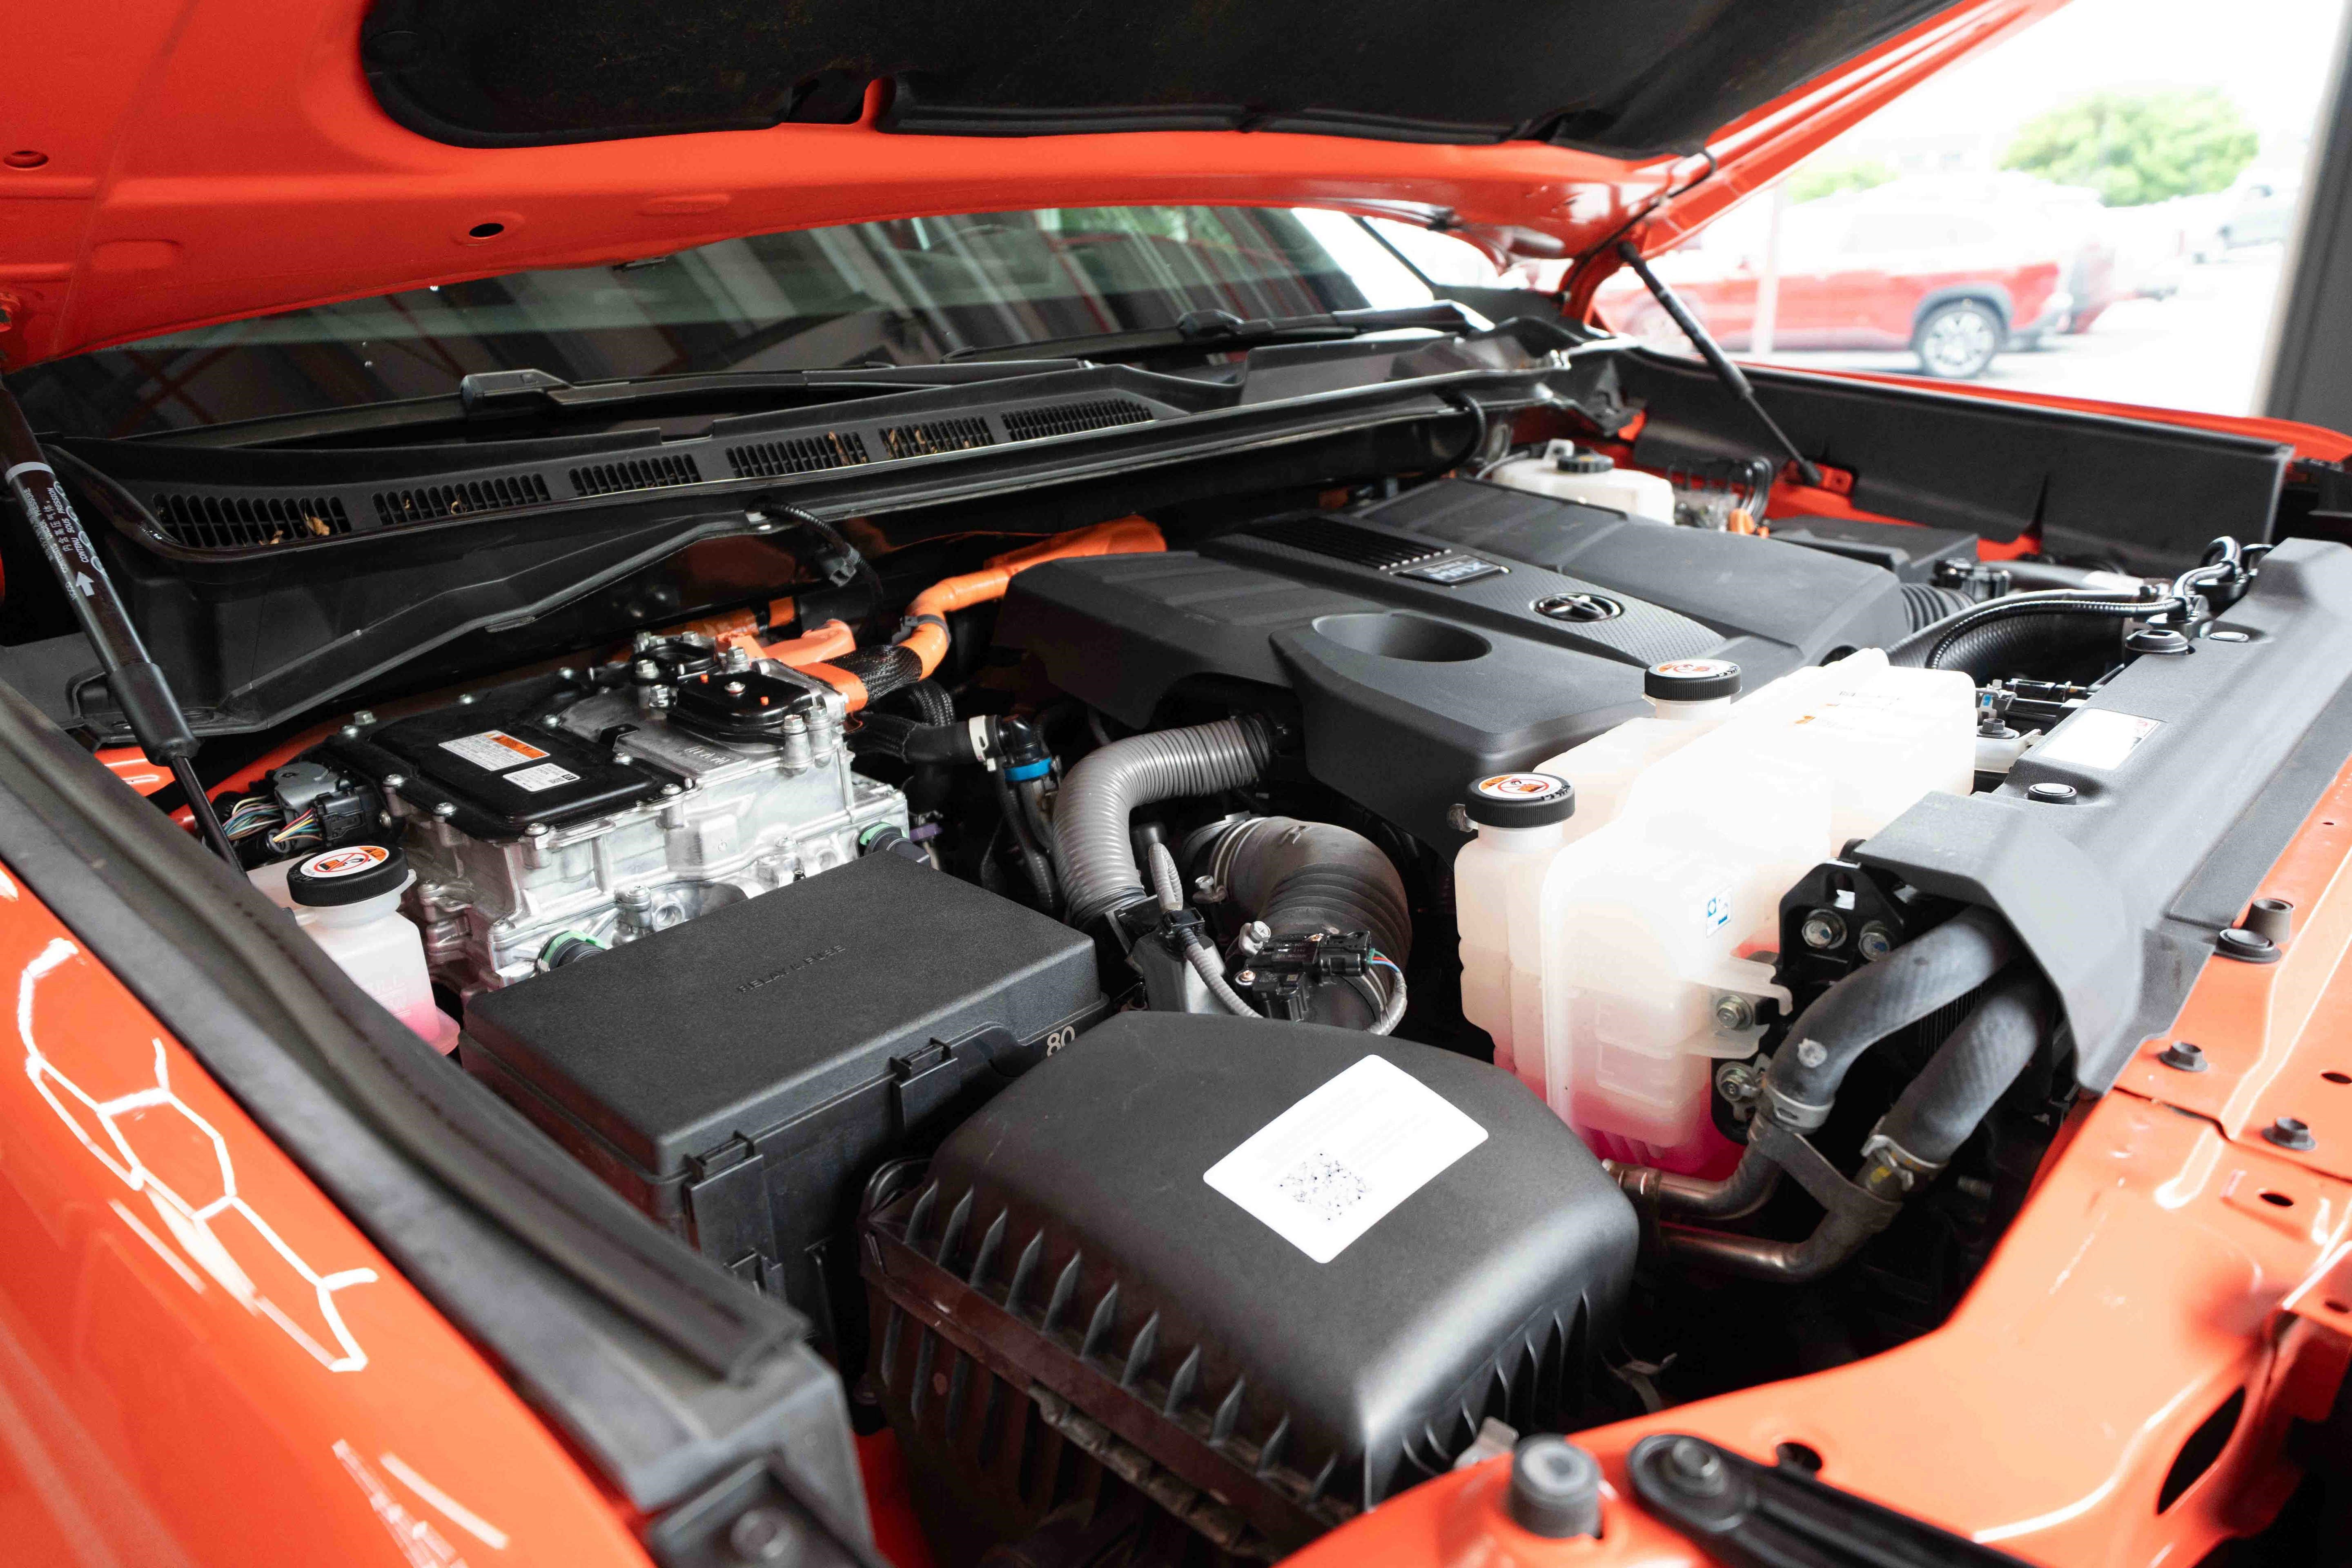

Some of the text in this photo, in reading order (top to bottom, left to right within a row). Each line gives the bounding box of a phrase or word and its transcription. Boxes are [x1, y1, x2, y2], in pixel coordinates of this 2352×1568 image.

[24, 487, 42, 517] PRESSURE
[39, 519, 53, 540] UNDER
[47, 488, 89, 563] CONTENU SOUS PRESSION
[51, 543, 69, 573] CONTENTS
[736, 966, 789, 993] RELAY
[803, 945, 846, 964] FUSE
[1046, 1025, 1076, 1058] 80
